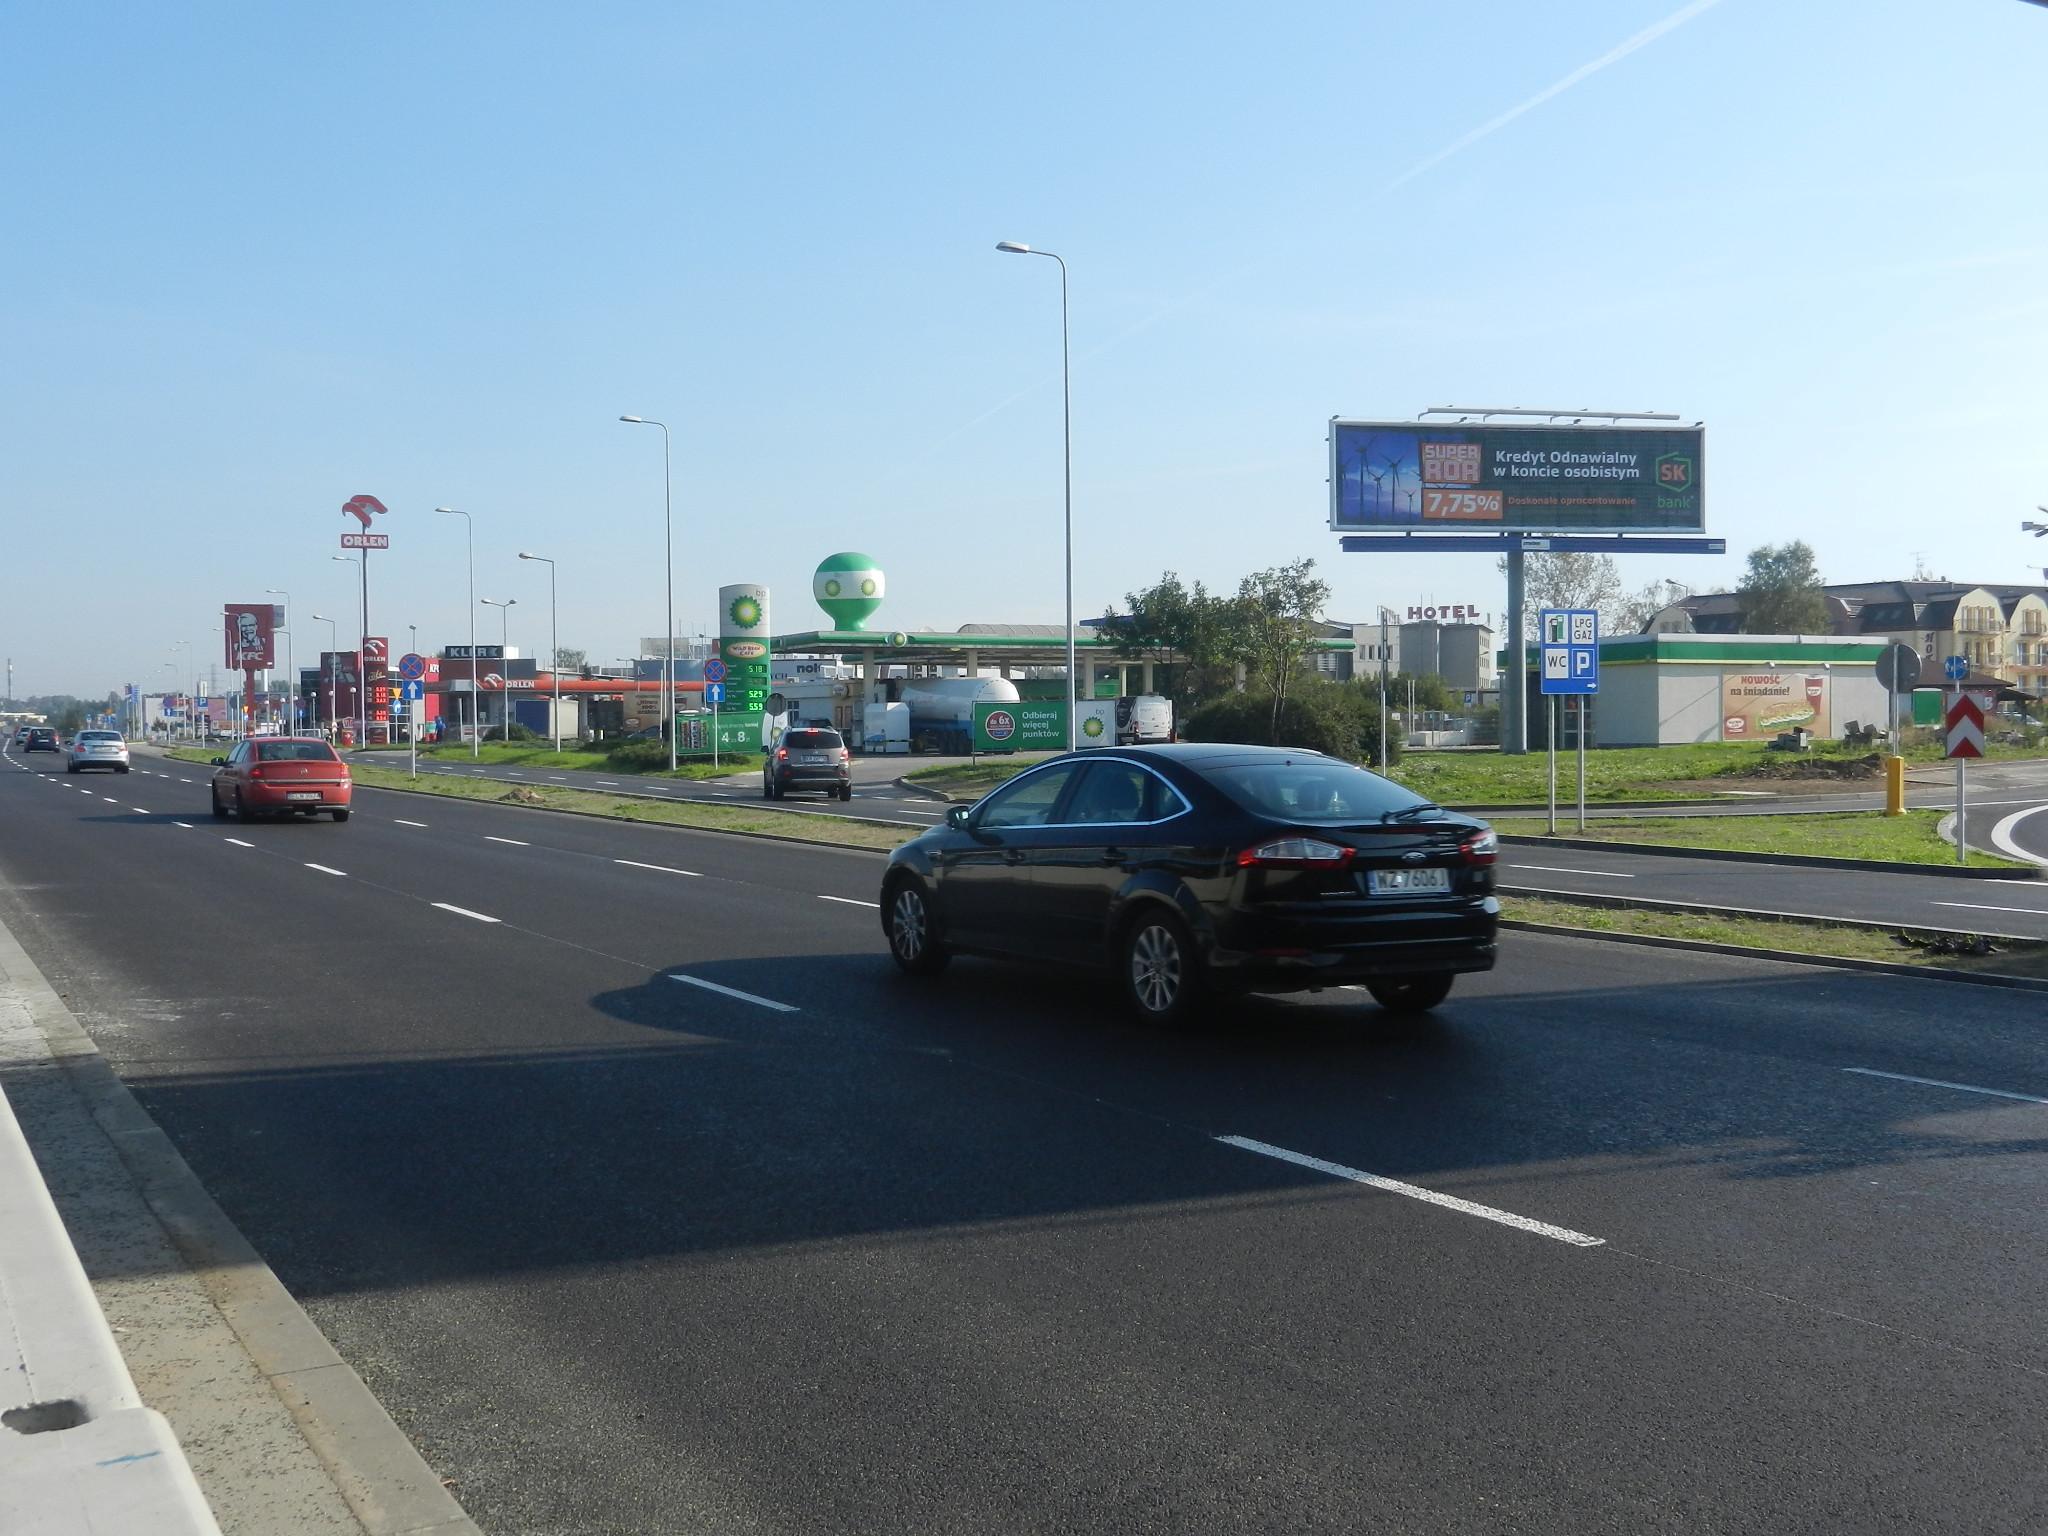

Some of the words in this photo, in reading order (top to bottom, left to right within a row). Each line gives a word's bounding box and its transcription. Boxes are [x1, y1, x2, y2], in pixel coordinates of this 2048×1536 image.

[1424, 445, 1478, 459] SUPER
[1495, 450, 1546, 465] Kredyt
[1550, 451, 1637, 466] Odnawialny
[1493, 467, 1506, 477] w
[1511, 465, 1560, 477] koncie
[1564, 466, 1640, 480] osobistym
[1660, 464, 1686, 481] SK
[1657, 495, 1690, 508] bank
[343, 535, 388, 547] ORLEN
[1407, 604, 1481, 620] HOTEL
[1574, 618, 1592, 629] LPG
[1573, 630, 1593, 640] GAZ
[1548, 655, 1567, 668] WC
[505, 680, 535, 689] ORLEN
[1740, 675, 1780, 684] NOWOŚĆ
[1730, 687, 1741, 696] na
[1743, 686, 1790, 697] śniadanie!
[1022, 711, 1058, 720] Odbieraj
[1022, 721, 1049, 730] więcej
[721, 731, 729, 743] 4
[737, 731, 746, 743] 8
[1022, 730, 1060, 740] punktów
